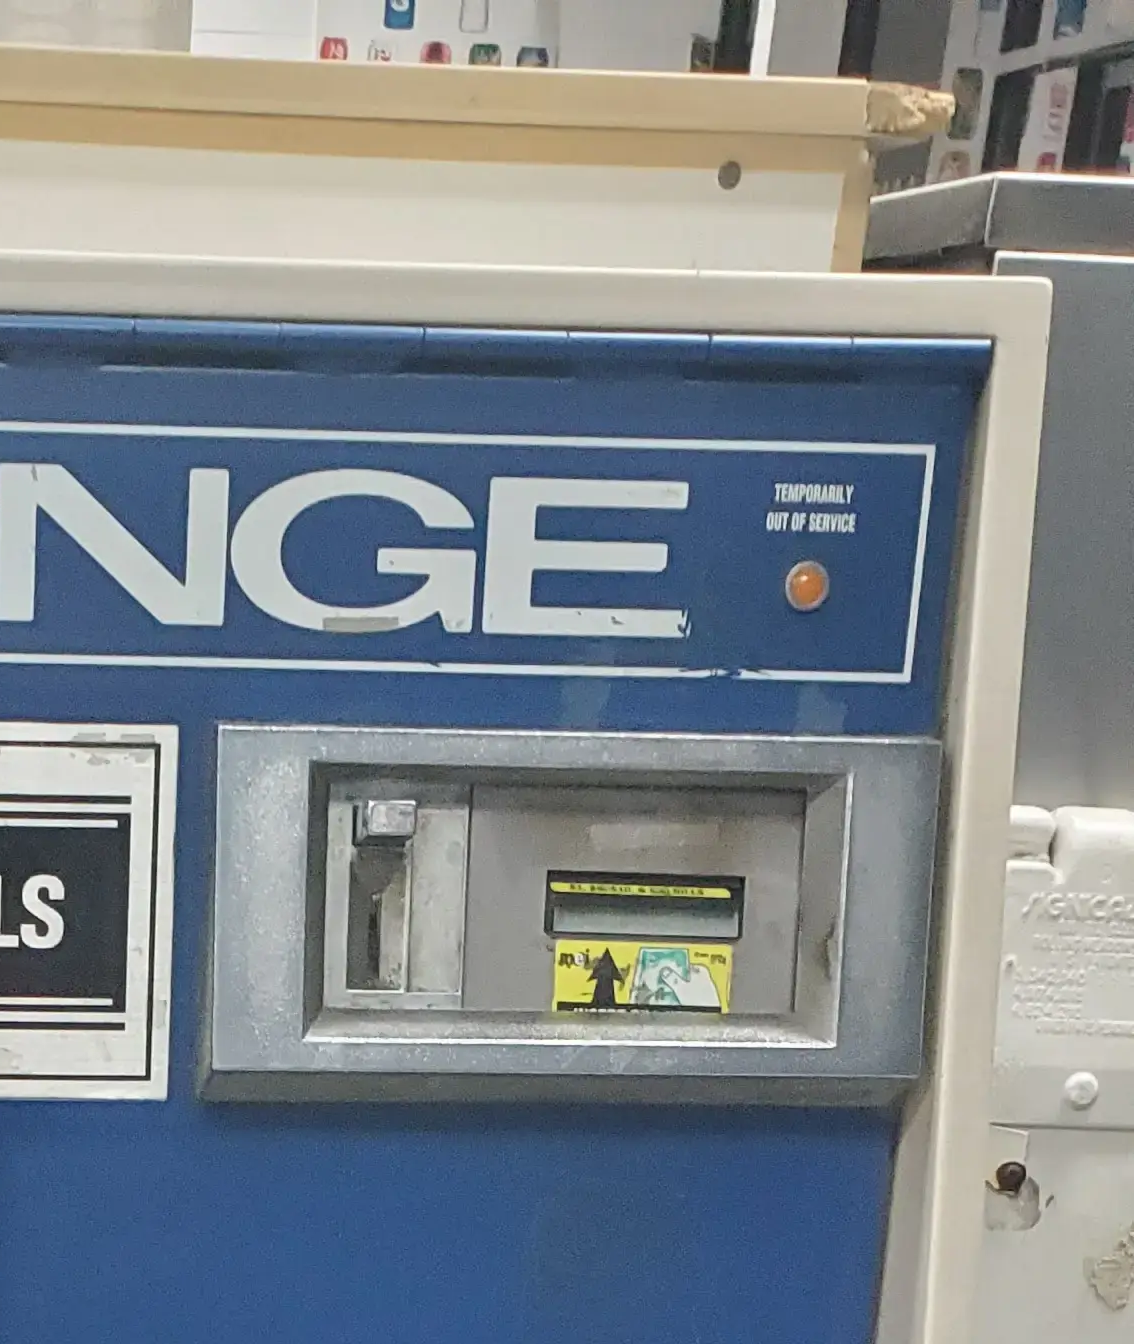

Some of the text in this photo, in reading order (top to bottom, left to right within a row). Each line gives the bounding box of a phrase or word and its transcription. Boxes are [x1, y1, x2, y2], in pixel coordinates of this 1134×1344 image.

[775, 483, 854, 504] TEMPORARILY
[766, 512, 856, 532] OUT OF SERVICE
